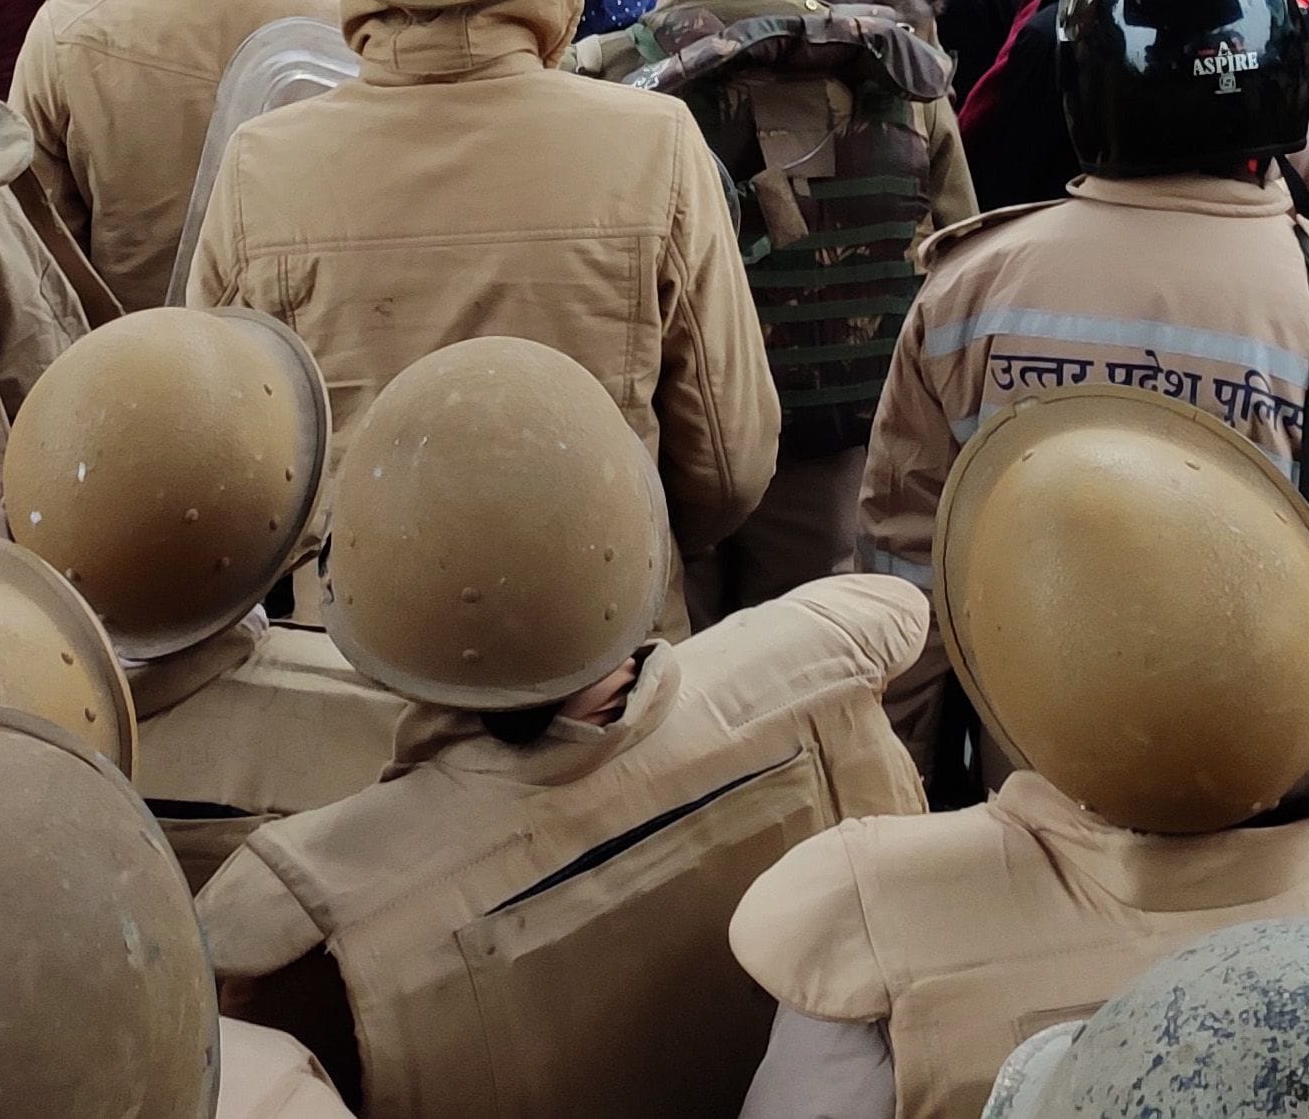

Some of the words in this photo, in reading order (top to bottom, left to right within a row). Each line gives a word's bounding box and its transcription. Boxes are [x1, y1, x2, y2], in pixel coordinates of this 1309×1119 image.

[1193, 51, 1260, 76] ASPIRE
[990, 354, 1095, 391] उत्तर
[1212, 368, 1305, 433] पुलिस
